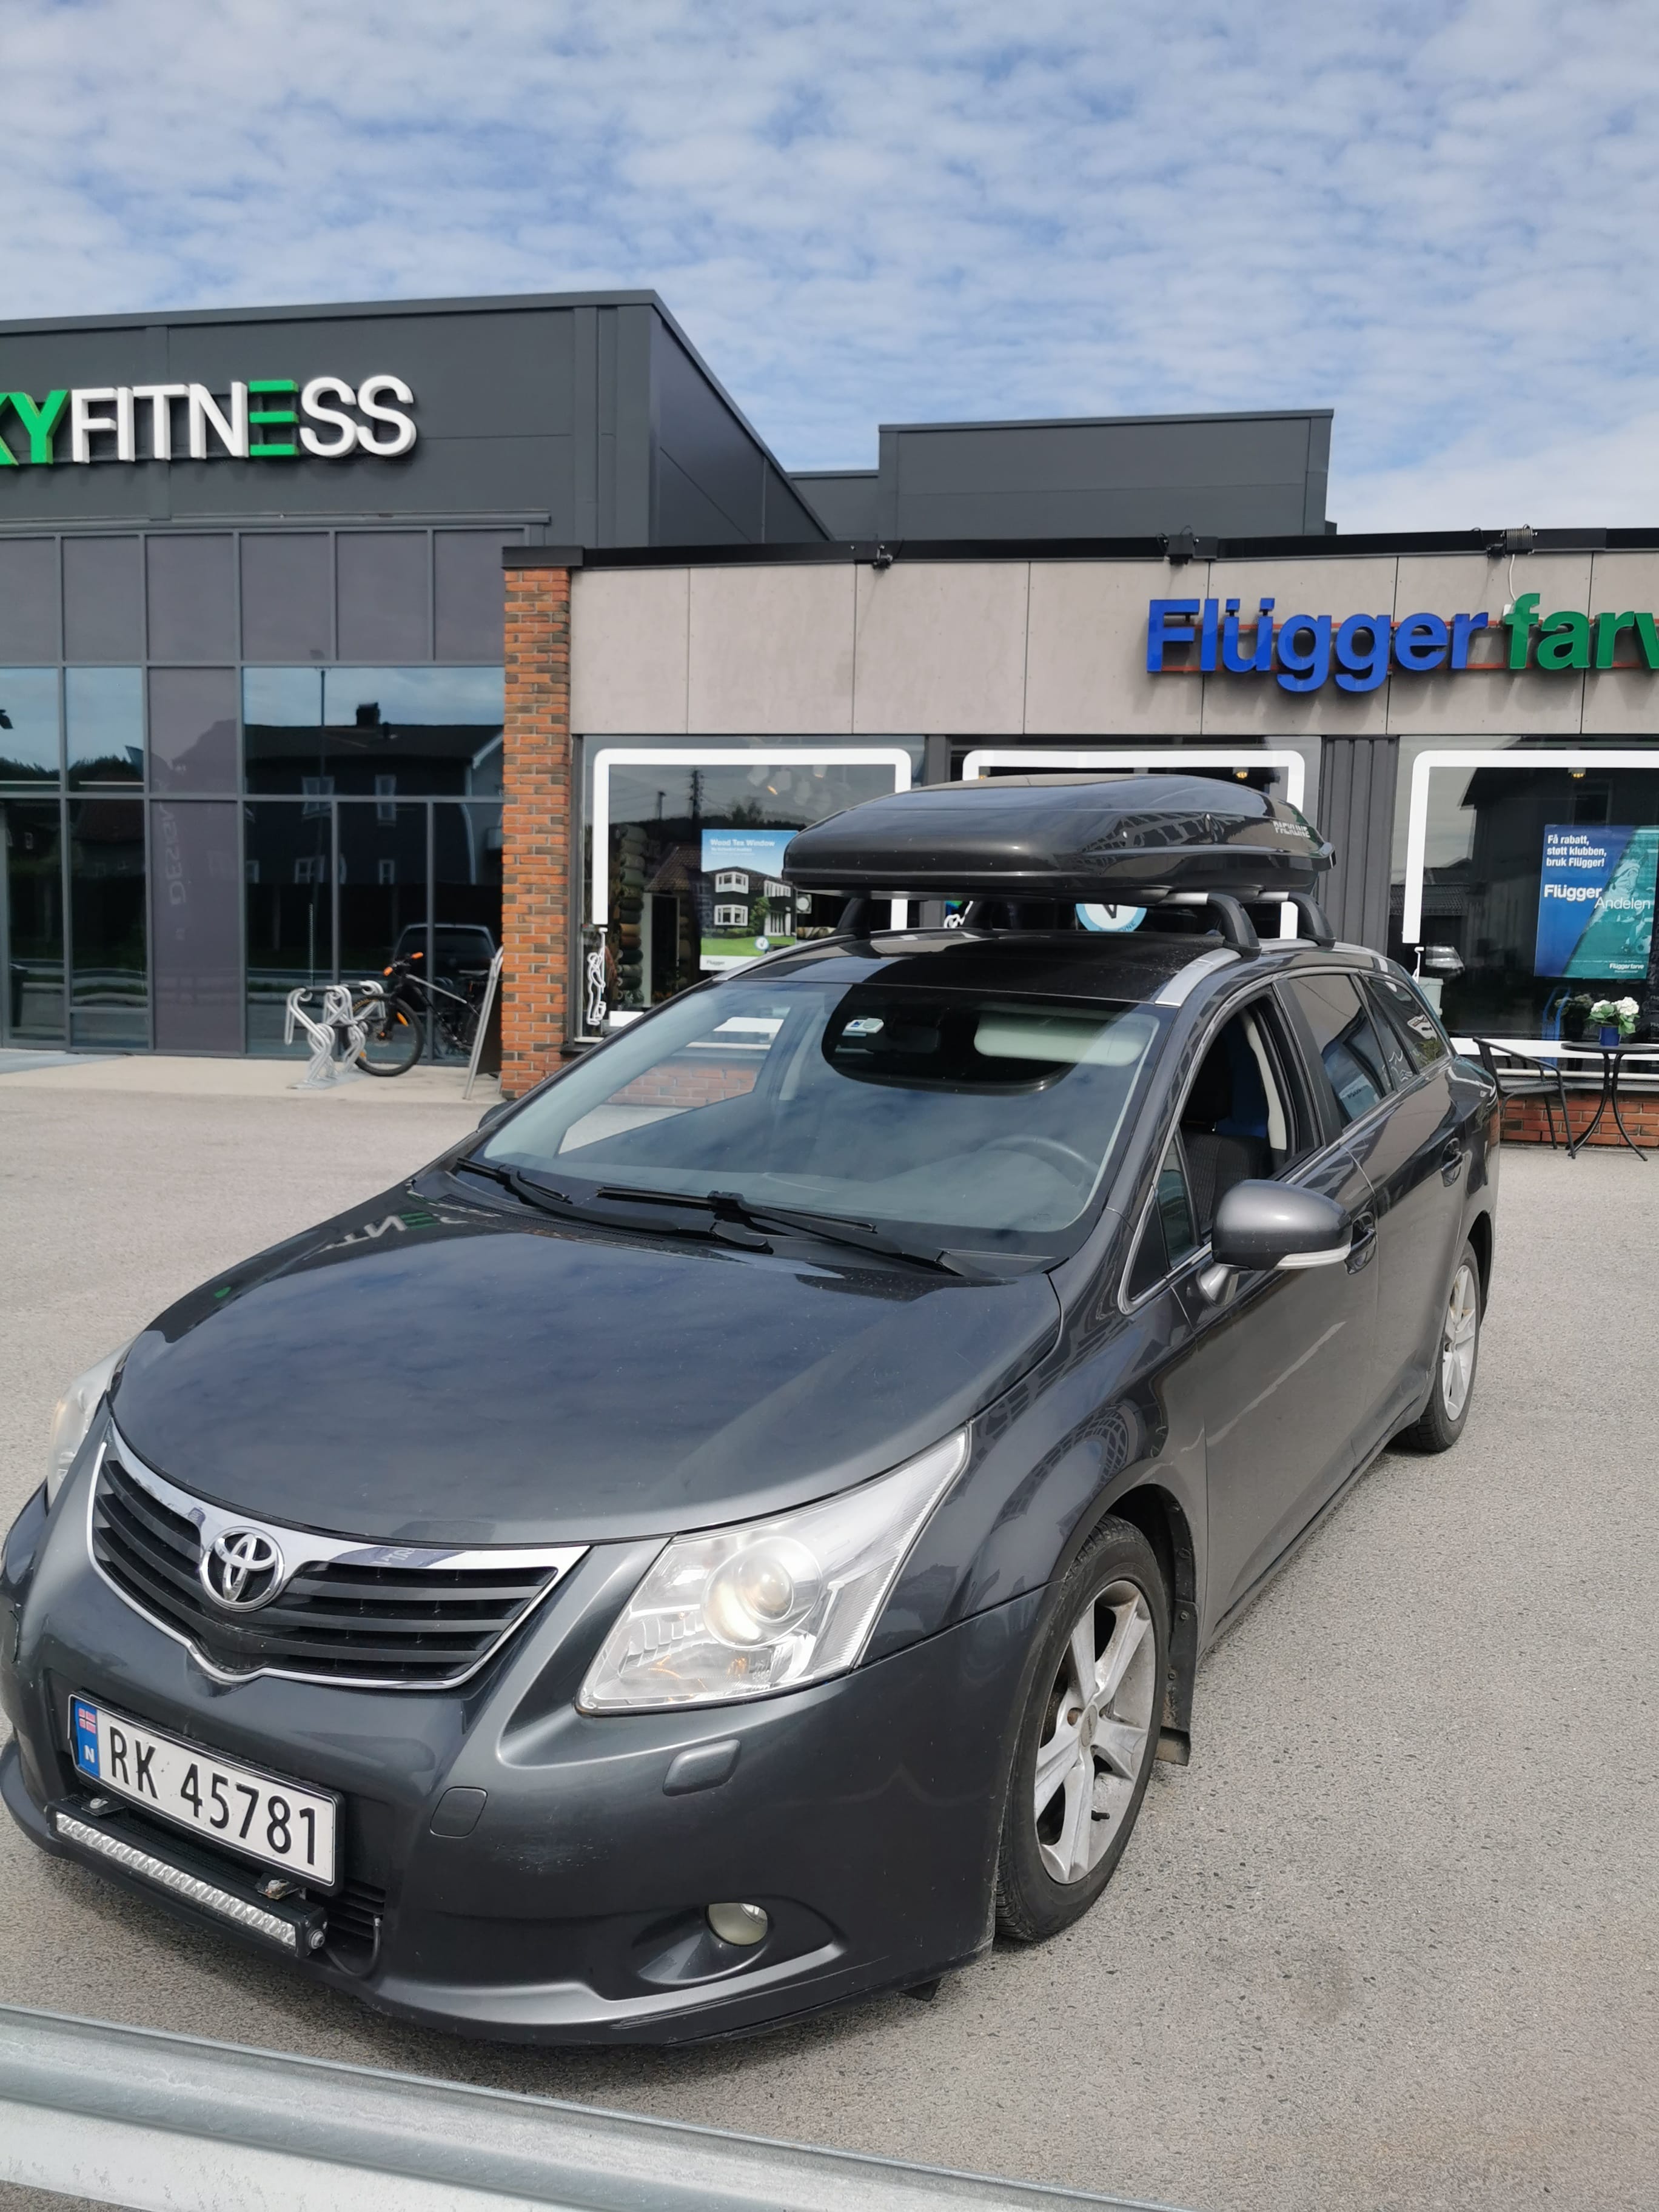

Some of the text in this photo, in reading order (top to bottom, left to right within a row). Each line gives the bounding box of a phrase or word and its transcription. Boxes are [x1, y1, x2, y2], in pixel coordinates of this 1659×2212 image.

[1147, 598, 1489, 692] Flügger
[1547, 834, 1589, 846] Få rabatt,
[1547, 847, 1607, 857] støtt klubben,
[1546, 857, 1605, 868] bruk Flügger!
[1544, 883, 1603, 902] Flügger
[1594, 896, 1651, 910] Andelen
[84, 1744, 95, 1764] N
[109, 1726, 316, 1866] RK 45781
